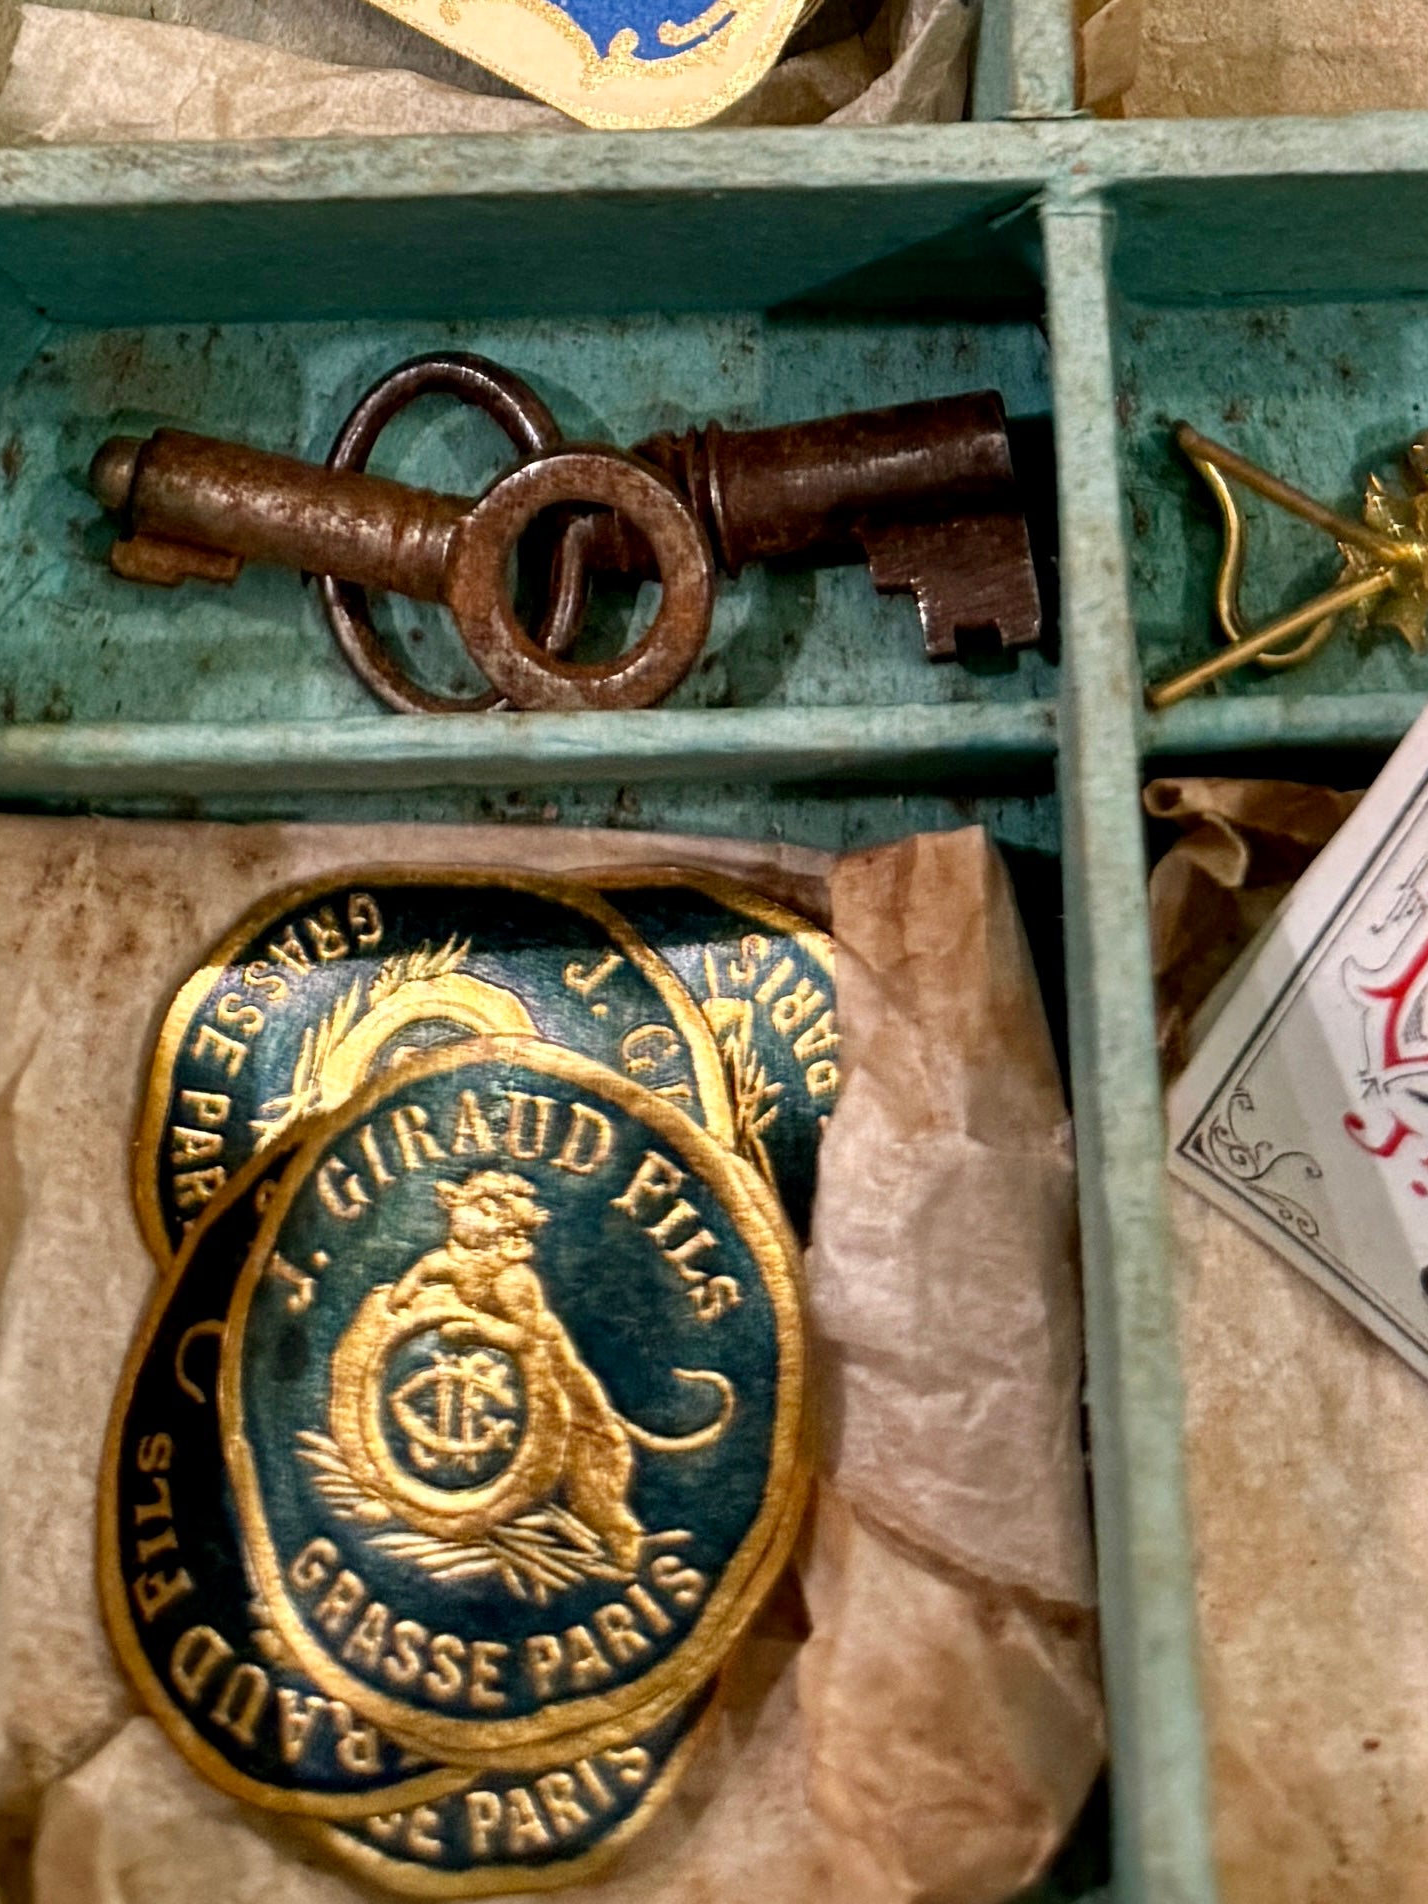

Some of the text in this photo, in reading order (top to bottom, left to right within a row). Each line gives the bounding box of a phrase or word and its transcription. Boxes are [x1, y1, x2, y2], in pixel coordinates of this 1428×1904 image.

[171, 892, 386, 1234] GRASSE PAR
[272, 1088, 742, 1324] J. GIRAUD FILS
[132, 1431, 386, 1775] RAUD FILS
[287, 1536, 708, 1709] GRASSE PARIS
[466, 1745, 651, 1858] PARIS
